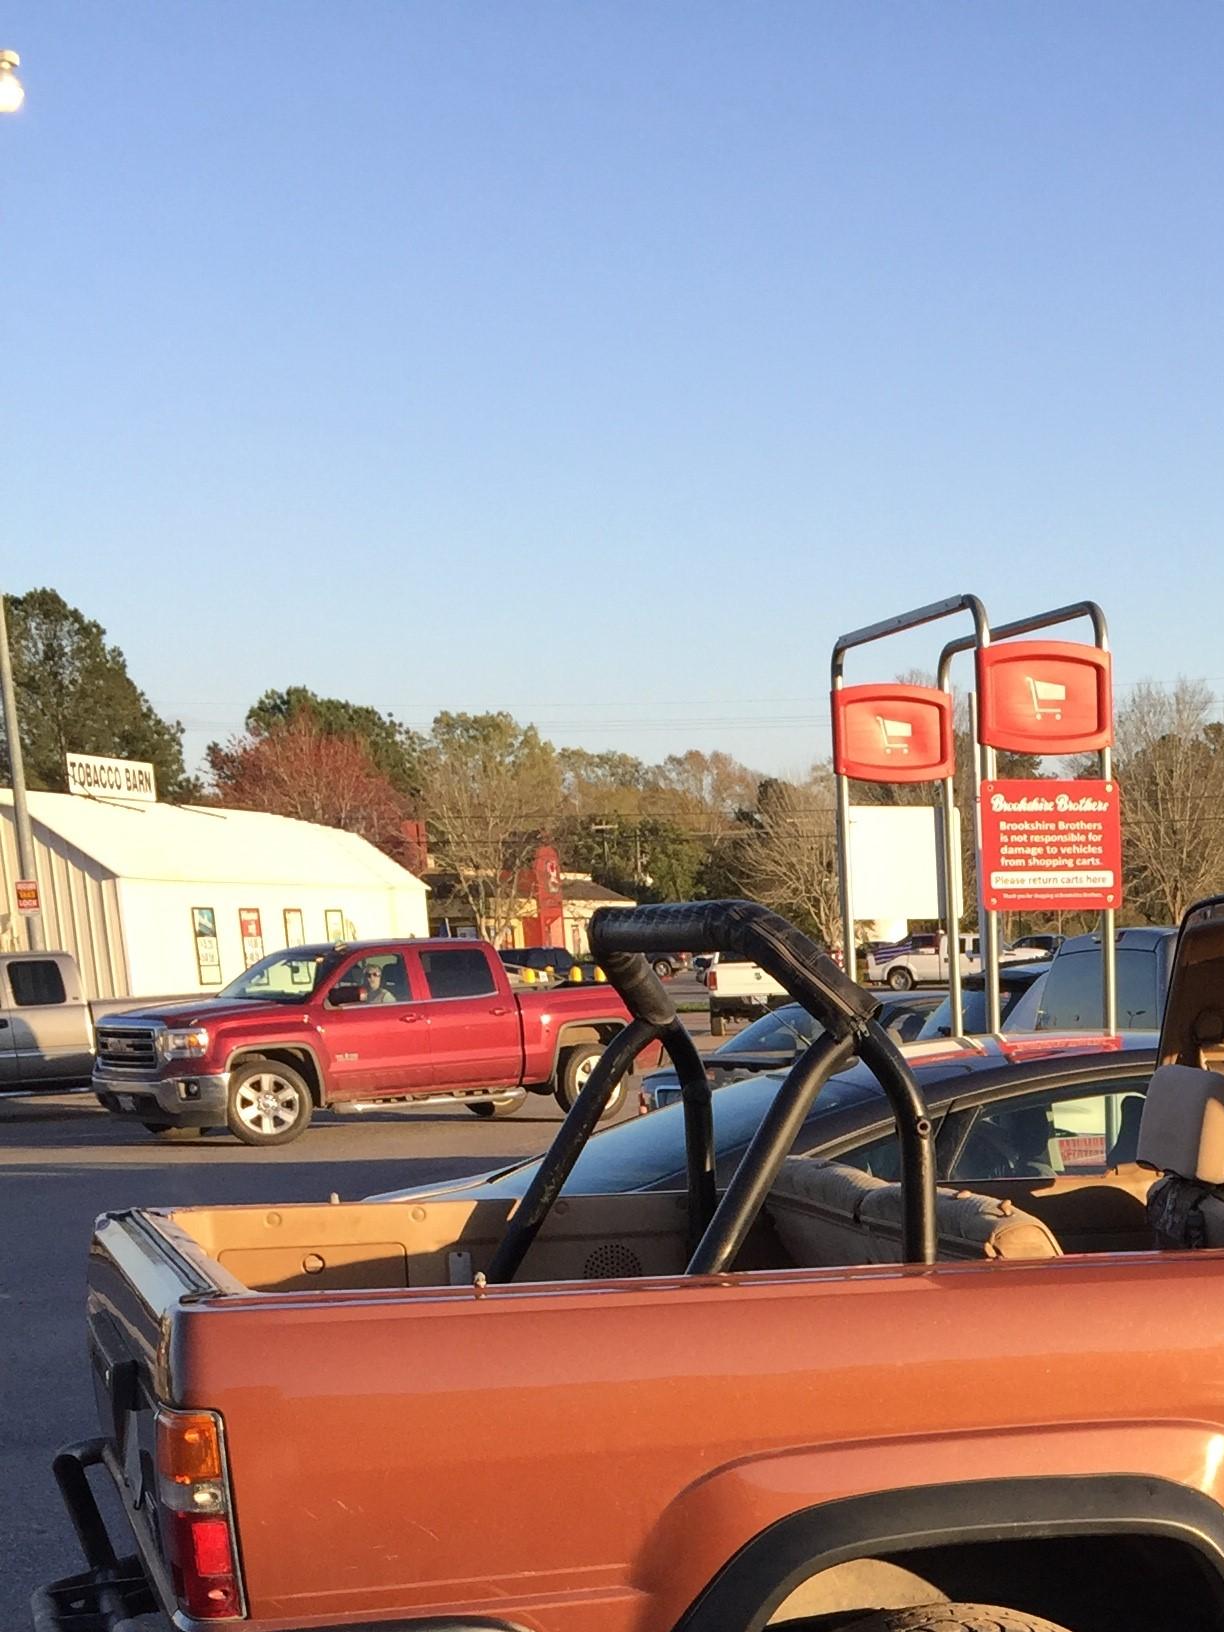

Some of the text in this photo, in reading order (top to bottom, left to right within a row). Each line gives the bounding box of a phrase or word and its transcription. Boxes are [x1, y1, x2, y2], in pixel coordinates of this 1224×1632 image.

[70, 762, 152, 793] TOBACCO BARN
[1000, 821, 1102, 831] Brookshire Brothers
[1000, 832, 1103, 844] is not responsible for
[1000, 845, 1103, 856] damage to vehicles
[1001, 857, 1026, 867] from
[1028, 857, 1074, 868] shopping
[995, 874, 1107, 885] Please return carts here
